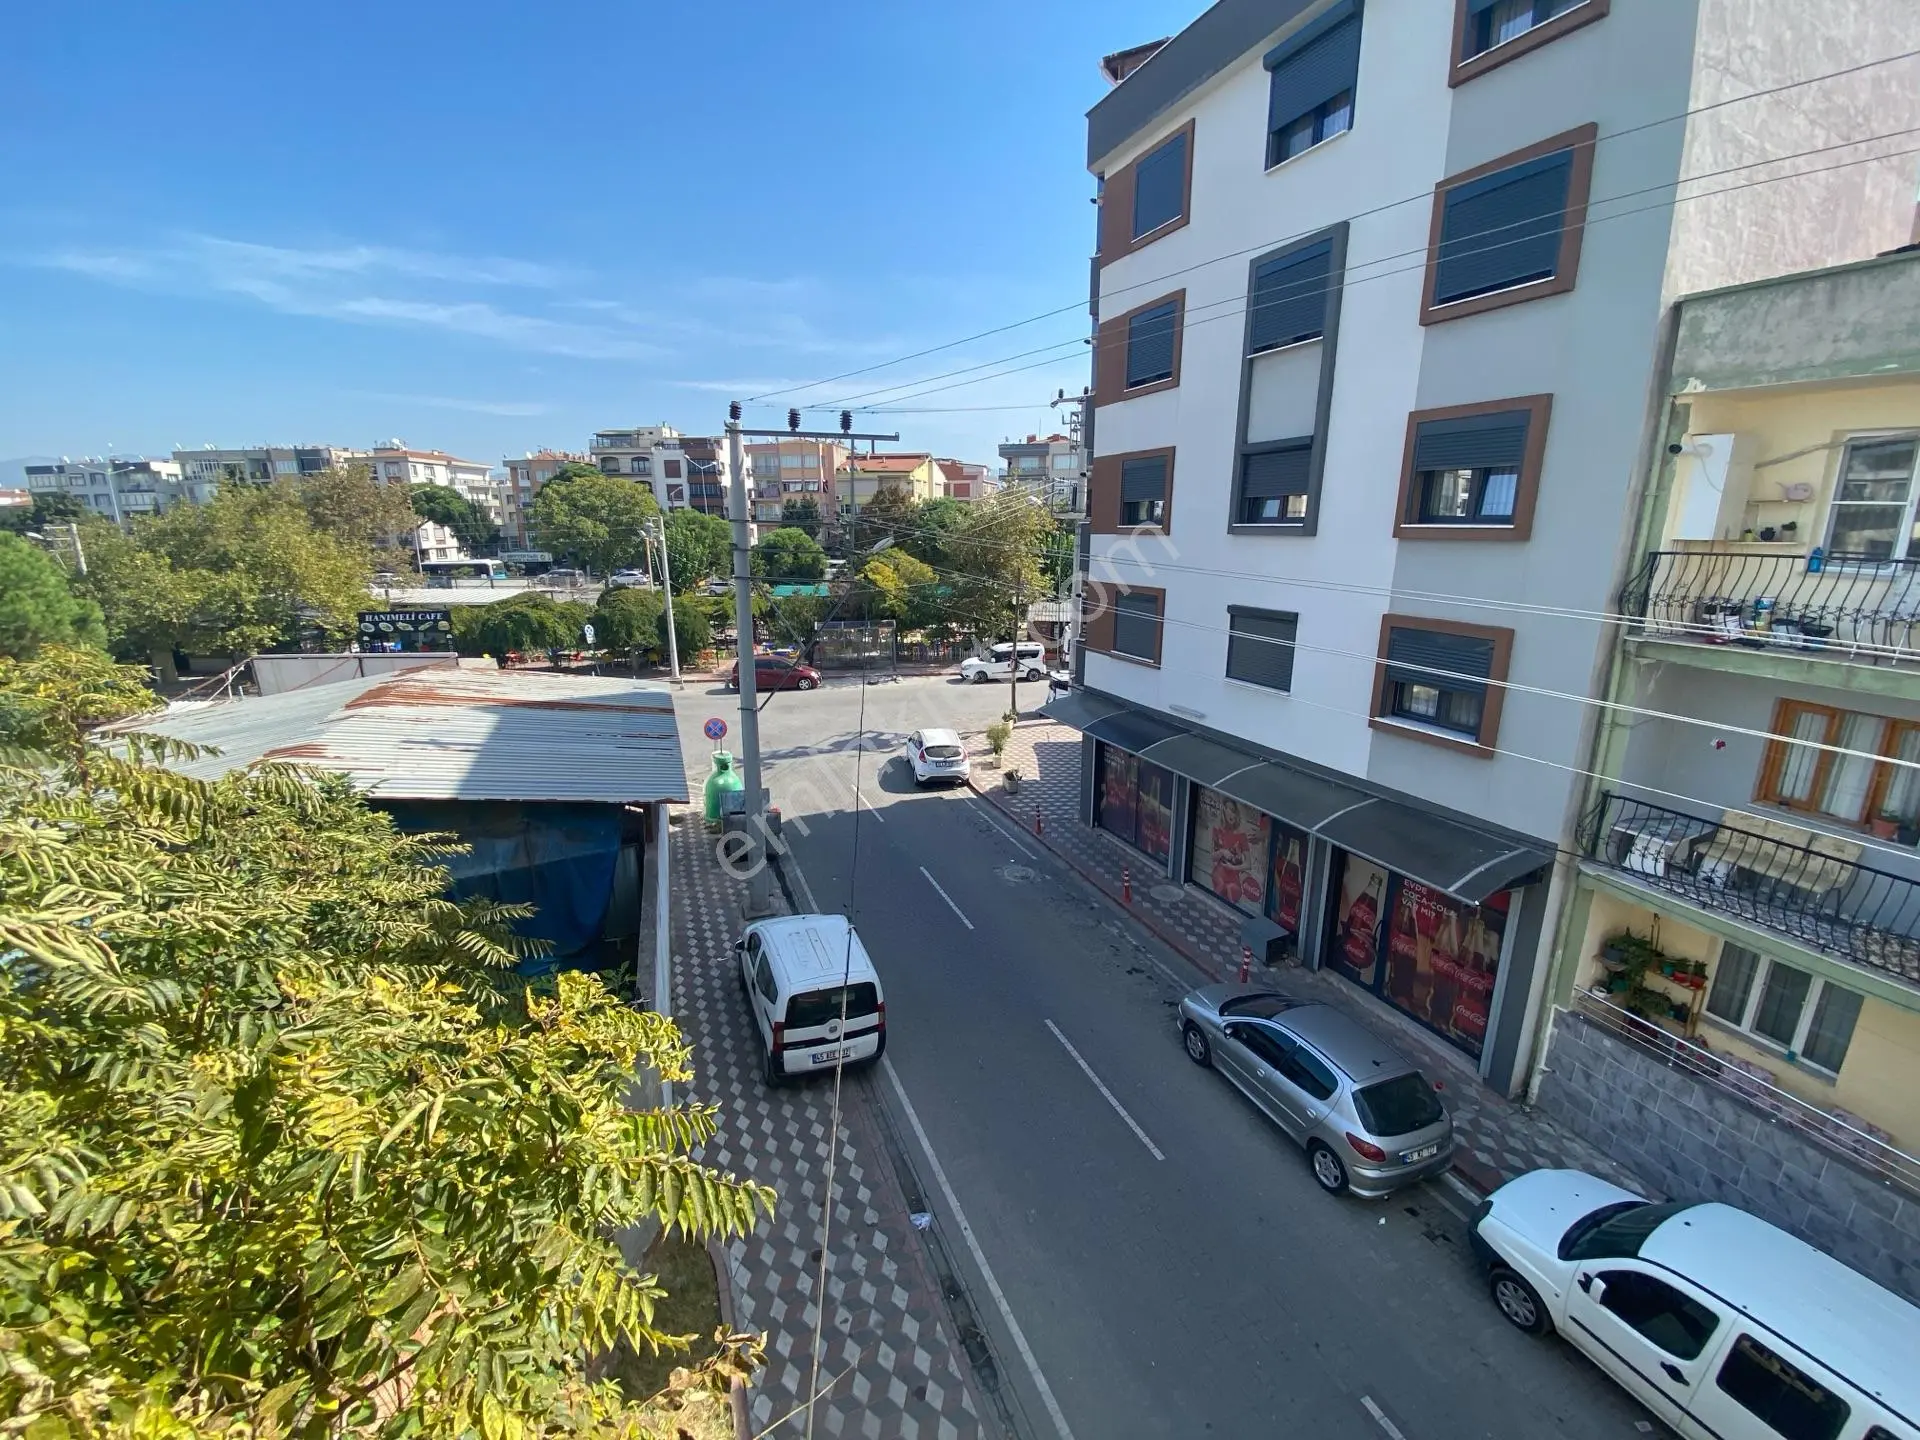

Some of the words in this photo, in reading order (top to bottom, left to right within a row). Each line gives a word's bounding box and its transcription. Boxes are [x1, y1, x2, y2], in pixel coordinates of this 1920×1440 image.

[365, 612, 415, 622] HANIMELİ
[418, 612, 443, 621] CAFE
[1404, 879, 1428, 895] EVDE
[1402, 888, 1457, 918] COCA-COLA
